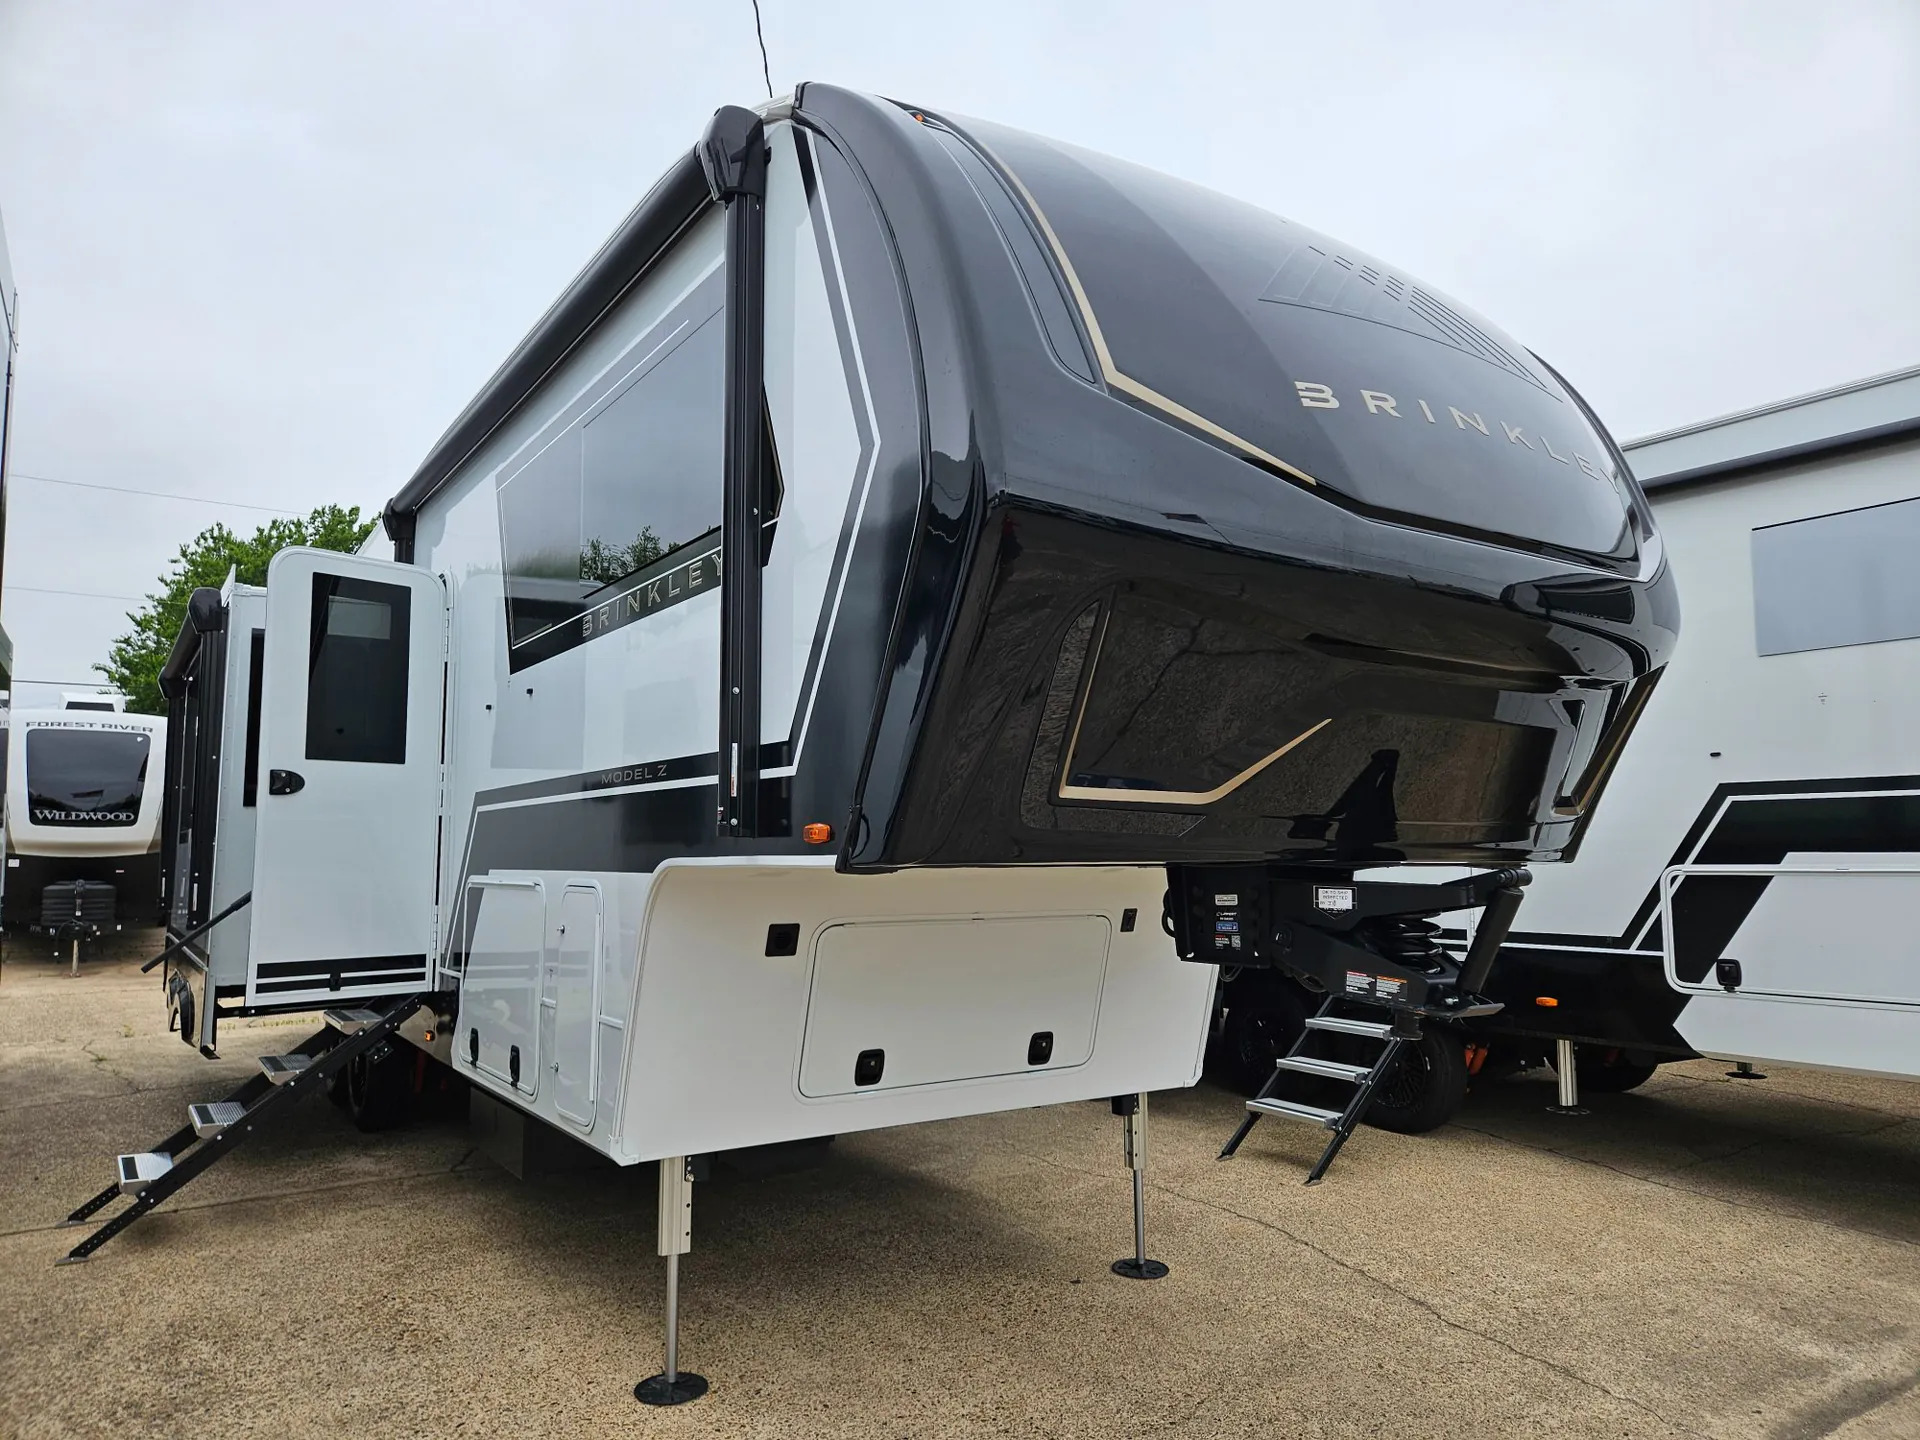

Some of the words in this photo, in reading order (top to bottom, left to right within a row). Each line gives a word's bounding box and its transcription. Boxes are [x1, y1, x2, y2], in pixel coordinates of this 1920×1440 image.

[581, 553, 721, 638] BRINKLEY
[26, 721, 97, 729] FOREST
[101, 723, 154, 733] RIVER
[601, 767, 653, 785] MODEL
[657, 764, 667, 777] Z
